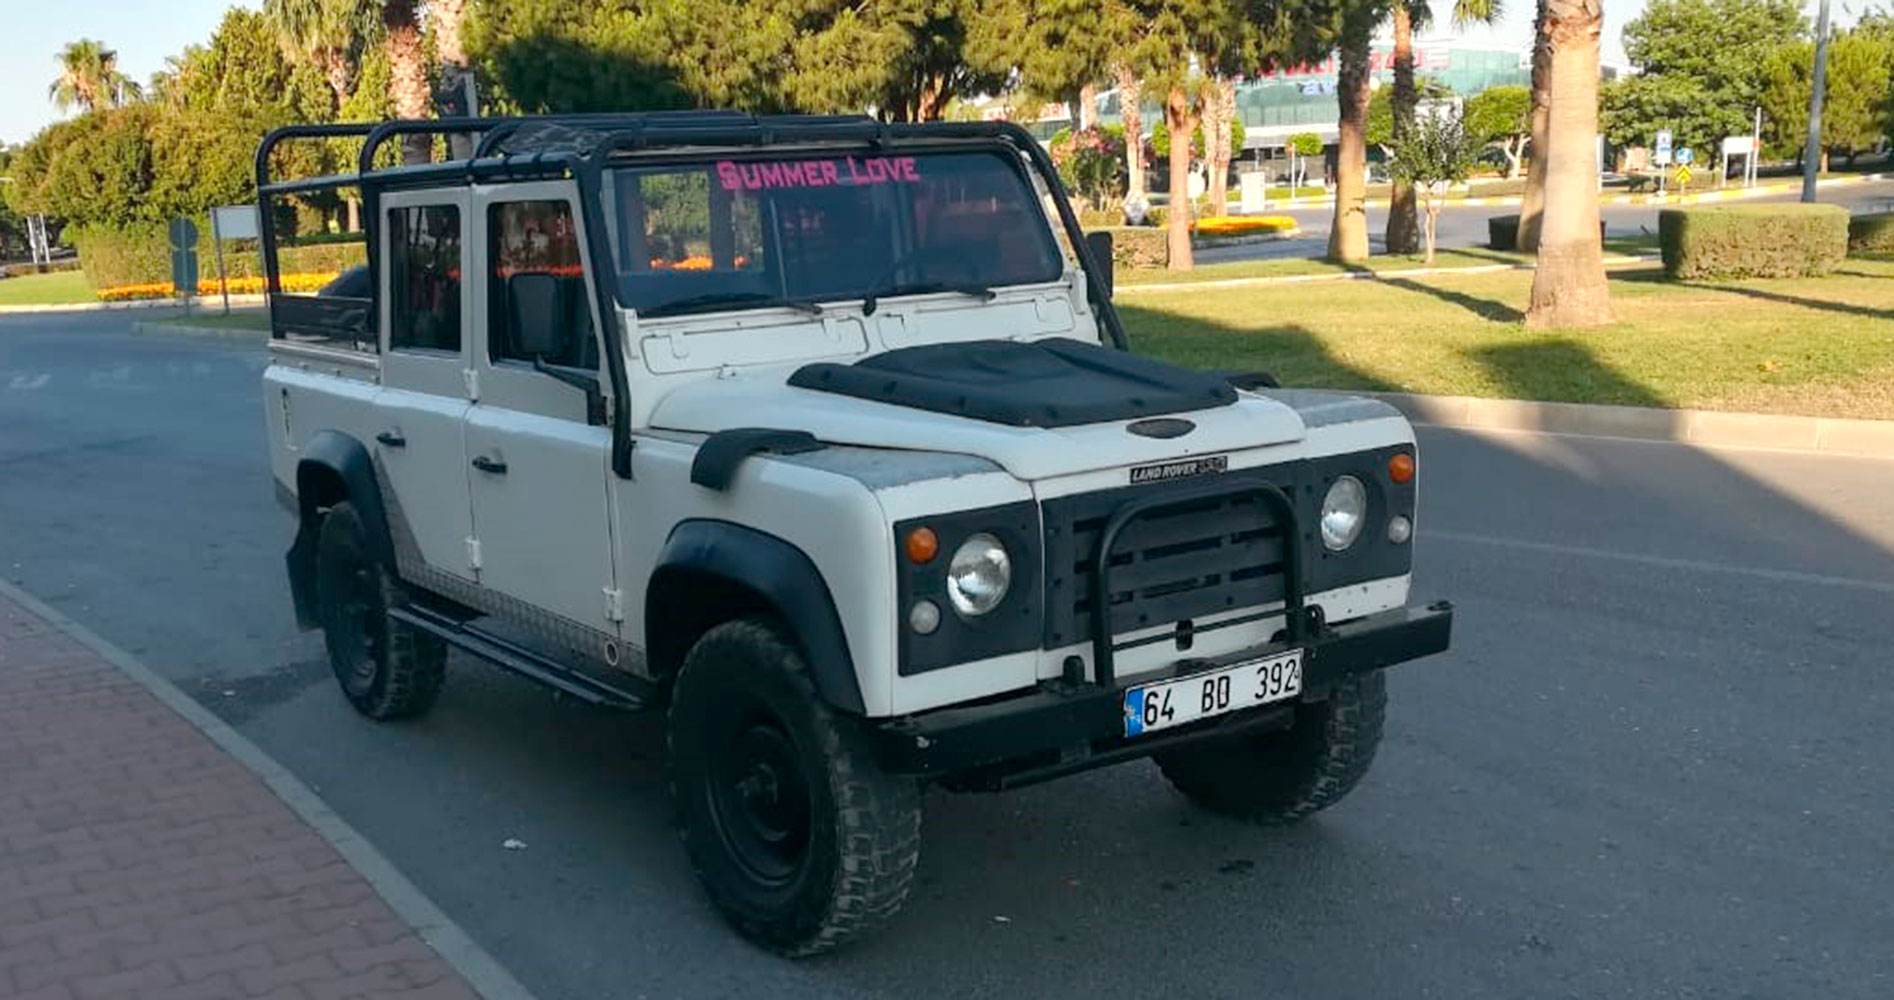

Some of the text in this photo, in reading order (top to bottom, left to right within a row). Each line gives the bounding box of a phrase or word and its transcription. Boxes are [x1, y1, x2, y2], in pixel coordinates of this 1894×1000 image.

[1133, 466, 1162, 481] LAND
[1162, 462, 1198, 478] ROVER
[1144, 688, 1174, 726] 64
[1201, 675, 1230, 713] BD
[1254, 658, 1297, 699] 392
